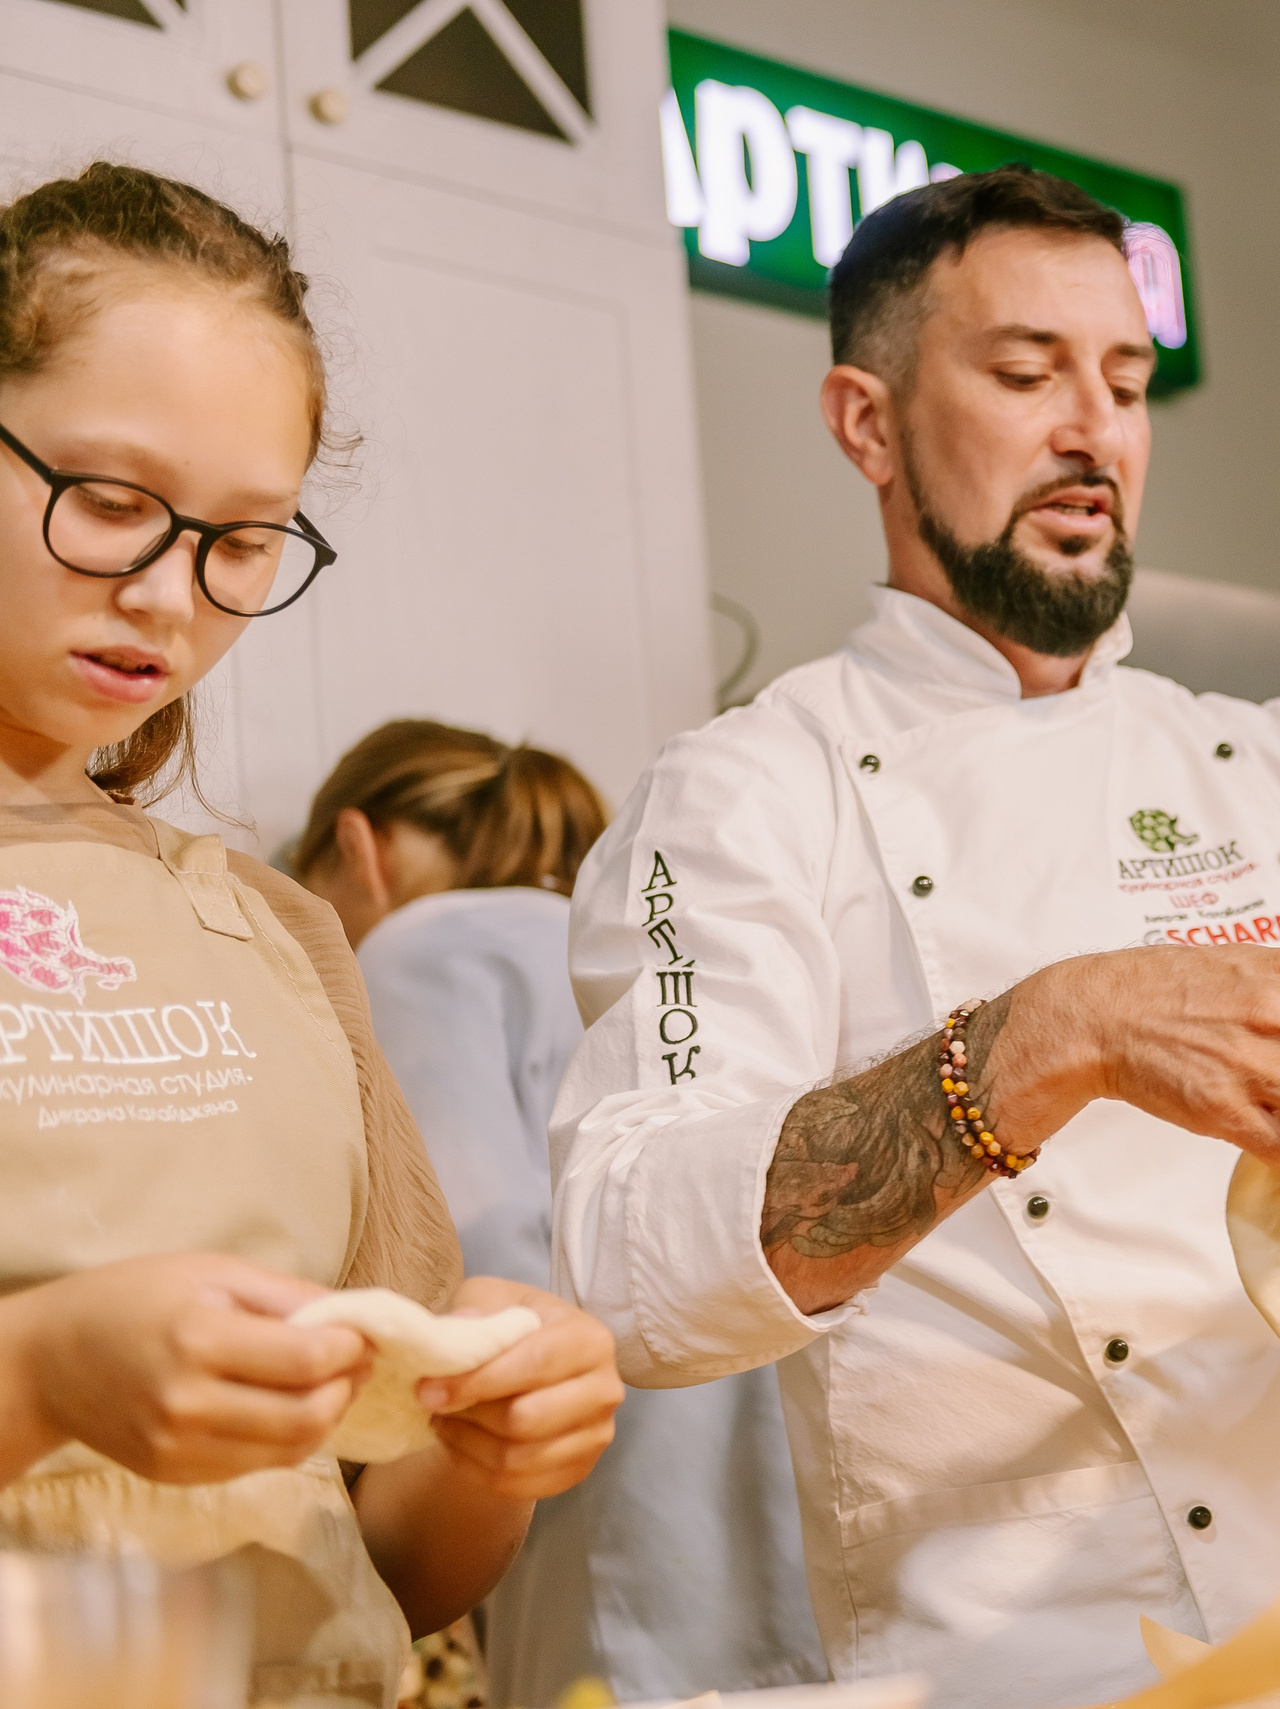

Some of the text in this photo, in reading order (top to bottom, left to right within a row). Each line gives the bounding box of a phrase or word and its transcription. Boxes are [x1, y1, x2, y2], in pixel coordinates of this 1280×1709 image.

[1118, 841, 1244, 880] АРТИШОК
[1169, 891, 1220, 909] ШЕФ
[641, 850, 701, 1085] АРТШОК
[0, 1000, 257, 1064] РТИШОК
